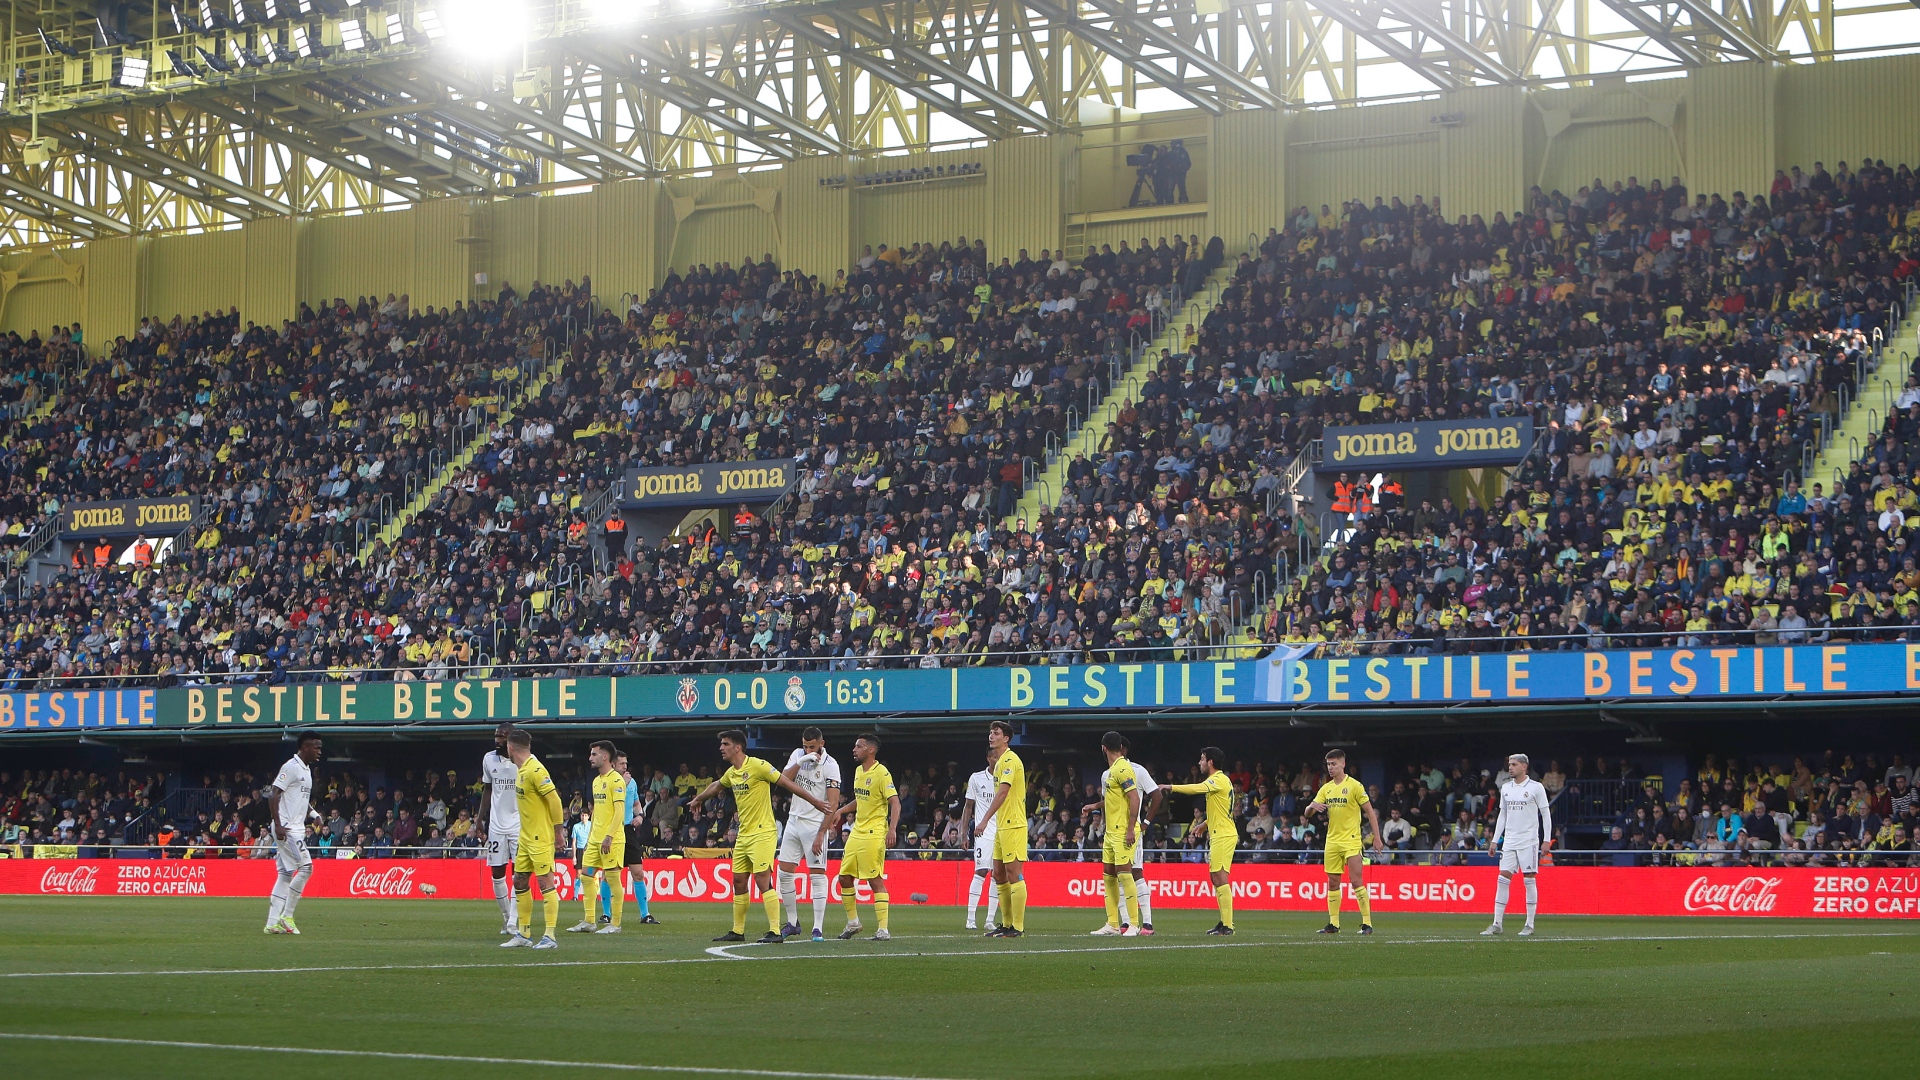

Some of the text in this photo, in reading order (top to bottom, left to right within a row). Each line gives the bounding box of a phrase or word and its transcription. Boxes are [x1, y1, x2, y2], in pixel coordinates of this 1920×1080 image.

[1010, 646, 1847, 707] BESTILE BESTILE BESTILE
[188, 679, 576, 723] BESTILE BESTILE
[714, 677, 767, 710] 0-0
[825, 678, 884, 704] 16:31
[0, 690, 154, 727] BESTILE
[976, 847, 984, 859] 3
[117, 863, 206, 879] ZERO AZÚCAR
[117, 878, 206, 894] ZERO CAFEÍNA
[1067, 879, 1104, 897] QUE
[1231, 881, 1262, 898] NO
[1266, 881, 1293, 898] TE
[1298, 881, 1357, 900] QUTE
[1366, 882, 1392, 900] EL
[1398, 878, 1475, 901] SUEÑO
[1813, 876, 1869, 893] ZERO
[1812, 896, 1920, 913] ZERO CAF
